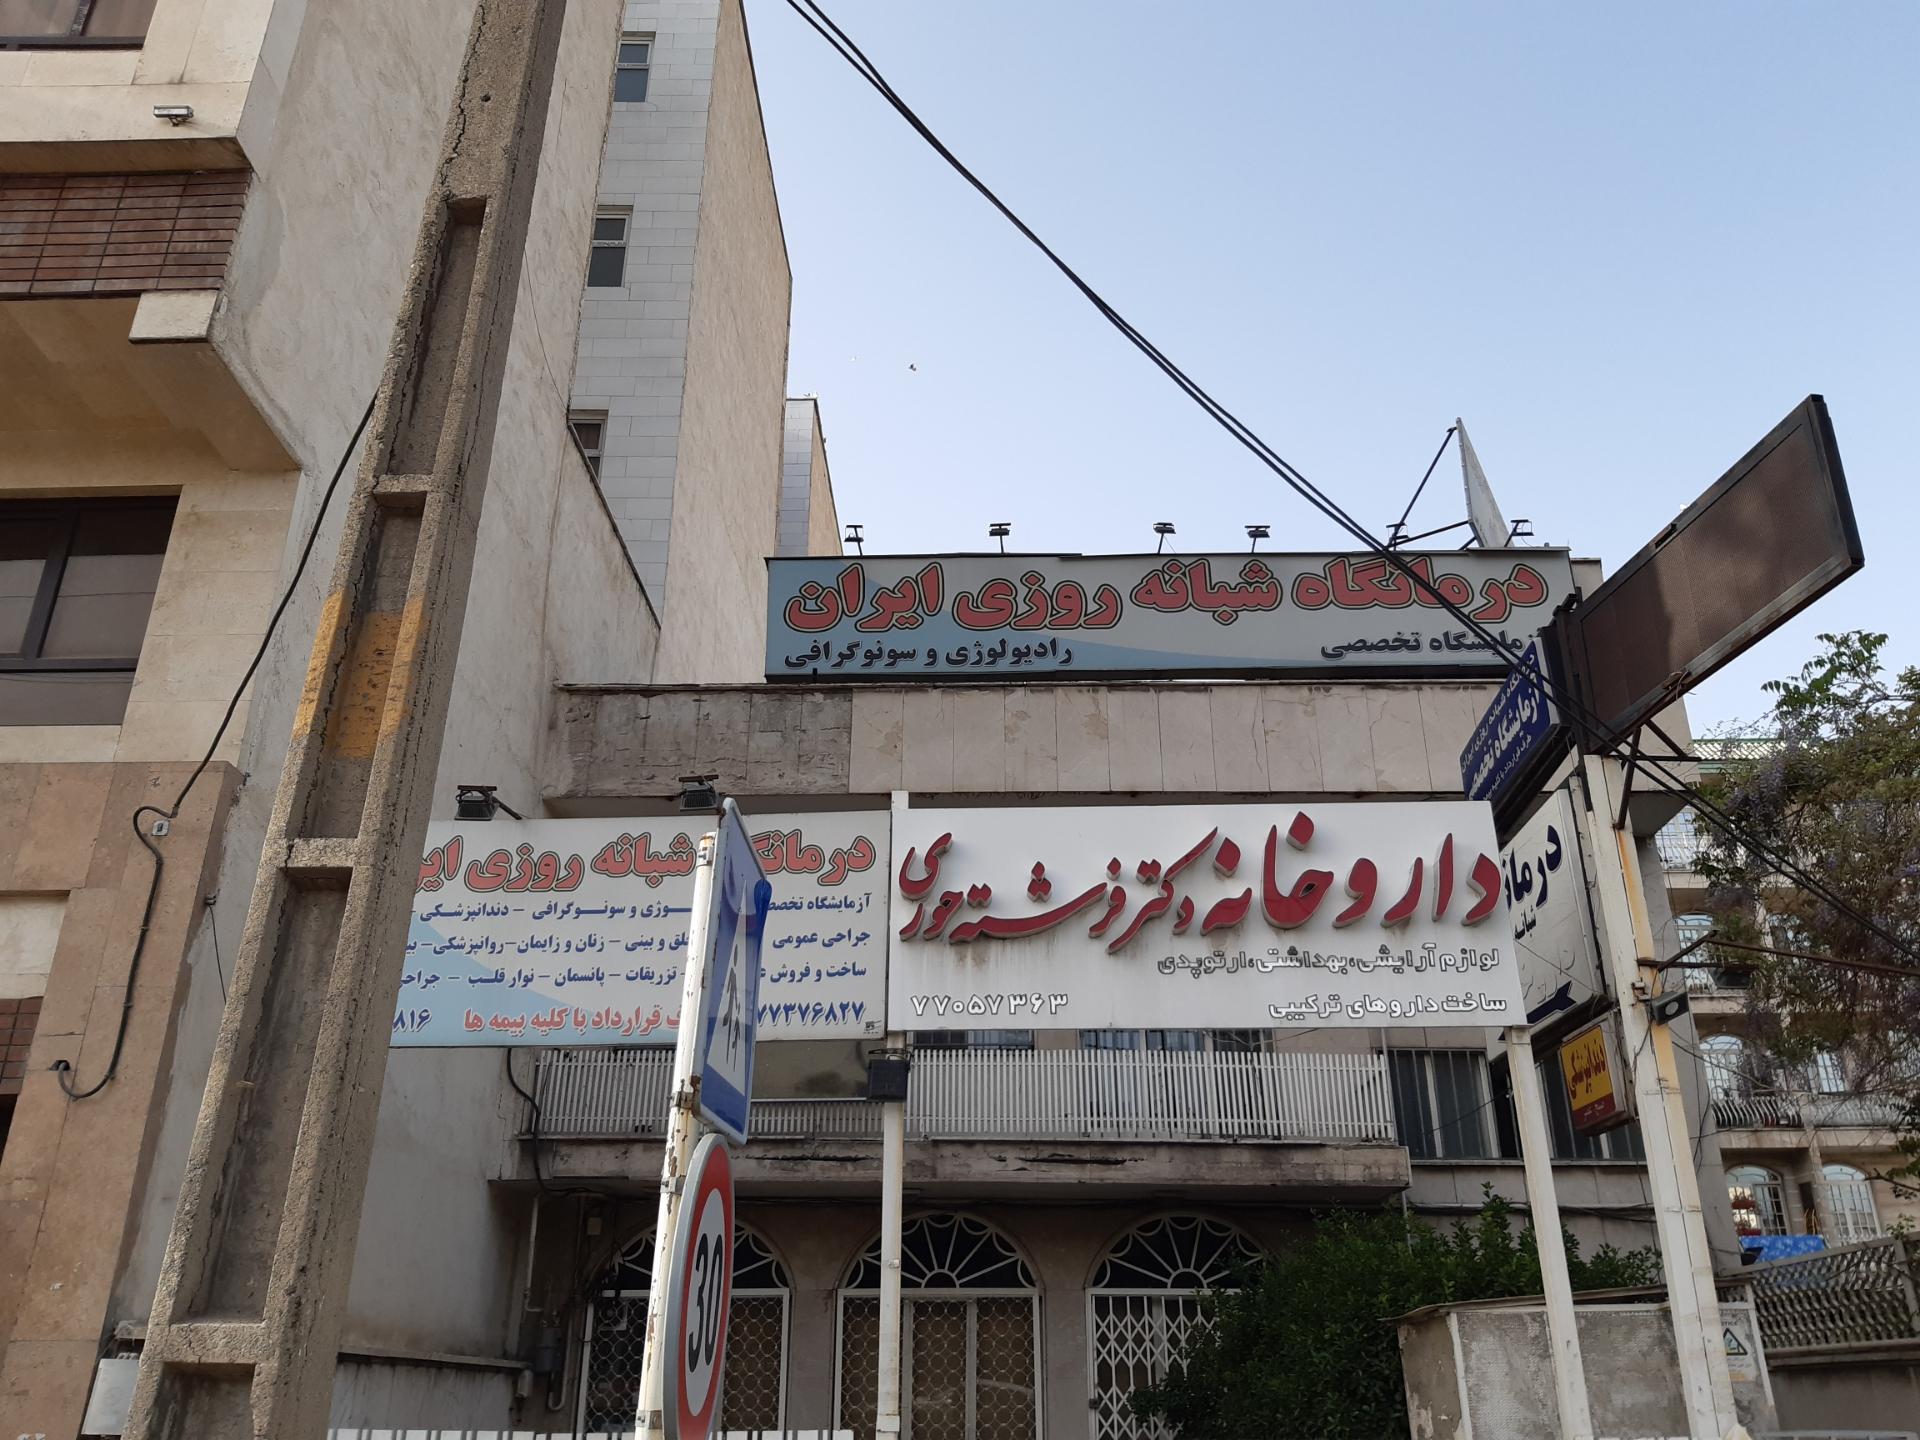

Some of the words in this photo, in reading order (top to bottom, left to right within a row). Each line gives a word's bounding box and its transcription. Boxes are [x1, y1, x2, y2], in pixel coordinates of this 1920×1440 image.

[783, 561, 944, 632] ایران
[952, 570, 1123, 631] روزی
[1131, 557, 1282, 626] شبانه
[1292, 555, 1548, 623] درمانگاه
[784, 638, 917, 668] سونوگرافی
[945, 637, 1073, 667] رادیولوژی
[1320, 631, 1422, 659] تخصصی
[926, 650, 937, 666] و
[464, 842, 585, 893] روزی
[590, 832, 697, 888] شبانه
[1201, 812, 1502, 934] داروخانه
[1107, 826, 1218, 954] دکتر
[420, 902, 509, 921] دندانپزشکی
[629, 906, 637, 918] و
[807, 893, 872, 913] آزمایشگاه
[433, 936, 504, 955] روانپزشکی
[517, 934, 560, 953] زایمان
[563, 940, 572, 953] و
[575, 933, 605, 952] زنان
[625, 934, 654, 951] بینی
[657, 938, 665, 951] و
[773, 932, 818, 948] عمومی
[822, 928, 871, 948] جراحی
[826, 961, 866, 977] ساخت
[1440, 947, 1500, 972] لوازم
[508, 968, 534, 988] نوار
[554, 967, 605, 987] پانسمان
[626, 966, 677, 985] تزریقات
[770, 962, 811, 983] فروش
[814, 968, 822, 982] و
[1269, 994, 1342, 1021] ترکیبی
[1346, 995, 1439, 1018] داروهای
[1442, 993, 1507, 1013] ساخت
[464, 1009, 485, 1032] ها
[489, 1013, 526, 1037] بیمه
[531, 1007, 570, 1036] کلیه
[573, 1007, 588, 1035] با
[592, 1005, 662, 1036] قرارداد
[688, 1232, 724, 1373] 30
